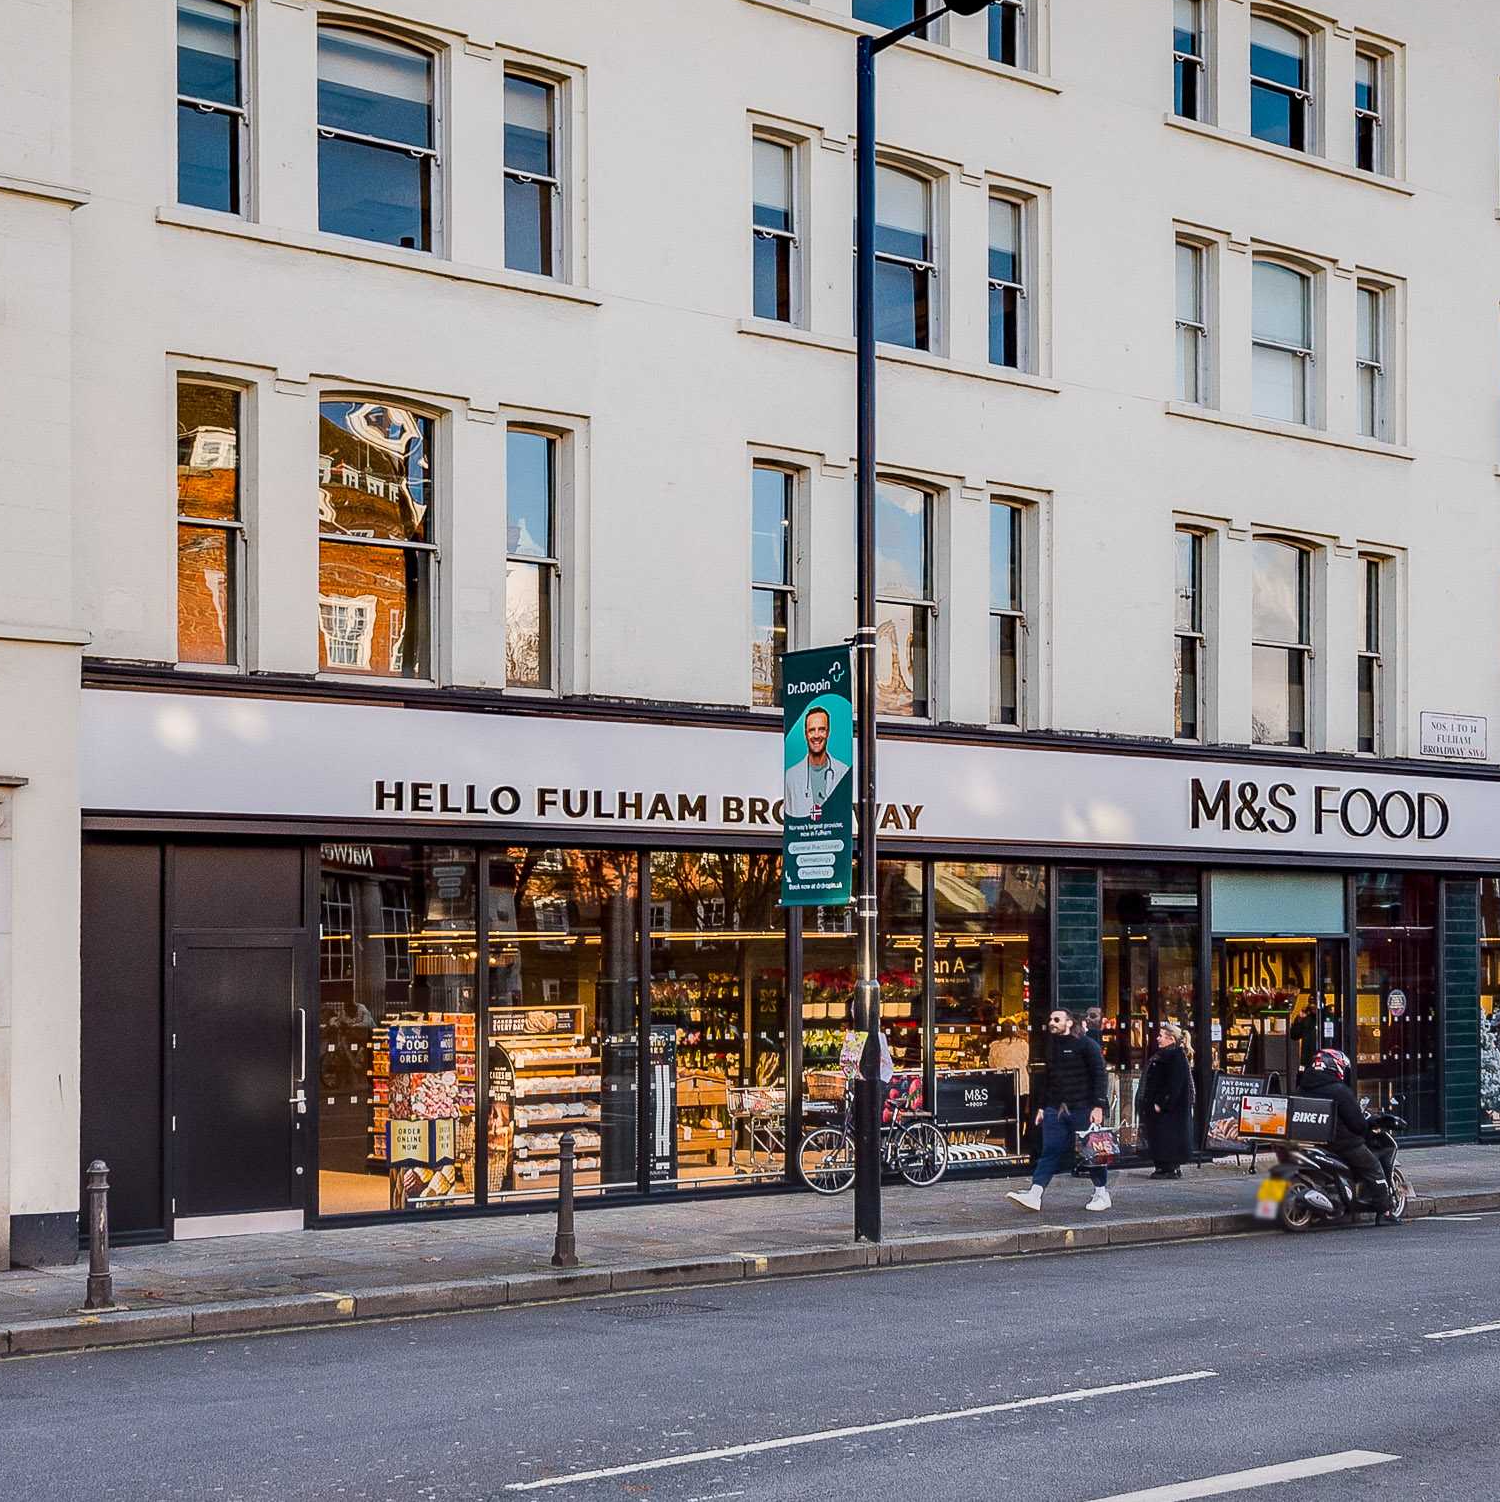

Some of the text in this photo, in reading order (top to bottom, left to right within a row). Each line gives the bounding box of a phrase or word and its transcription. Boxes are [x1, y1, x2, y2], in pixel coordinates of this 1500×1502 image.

[787, 678, 831, 695] Dr.Dropin
[1458, 723, 1468, 733] TO
[1437, 734, 1471, 745] FULHAM
[1423, 745, 1464, 756] BROADWAY
[373, 779, 924, 831] HELLO FULHAM BRAY
[1188, 777, 1449, 840] M&S FOOD
[914, 956, 966, 974] Pan A
[399, 1054, 429, 1064] ORDER
[964, 1088, 989, 1101] M&S
[1221, 1087, 1249, 1096] PASTRY
[1291, 1111, 1318, 1124] BIKE
[1317, 1113, 1329, 1124] IT
